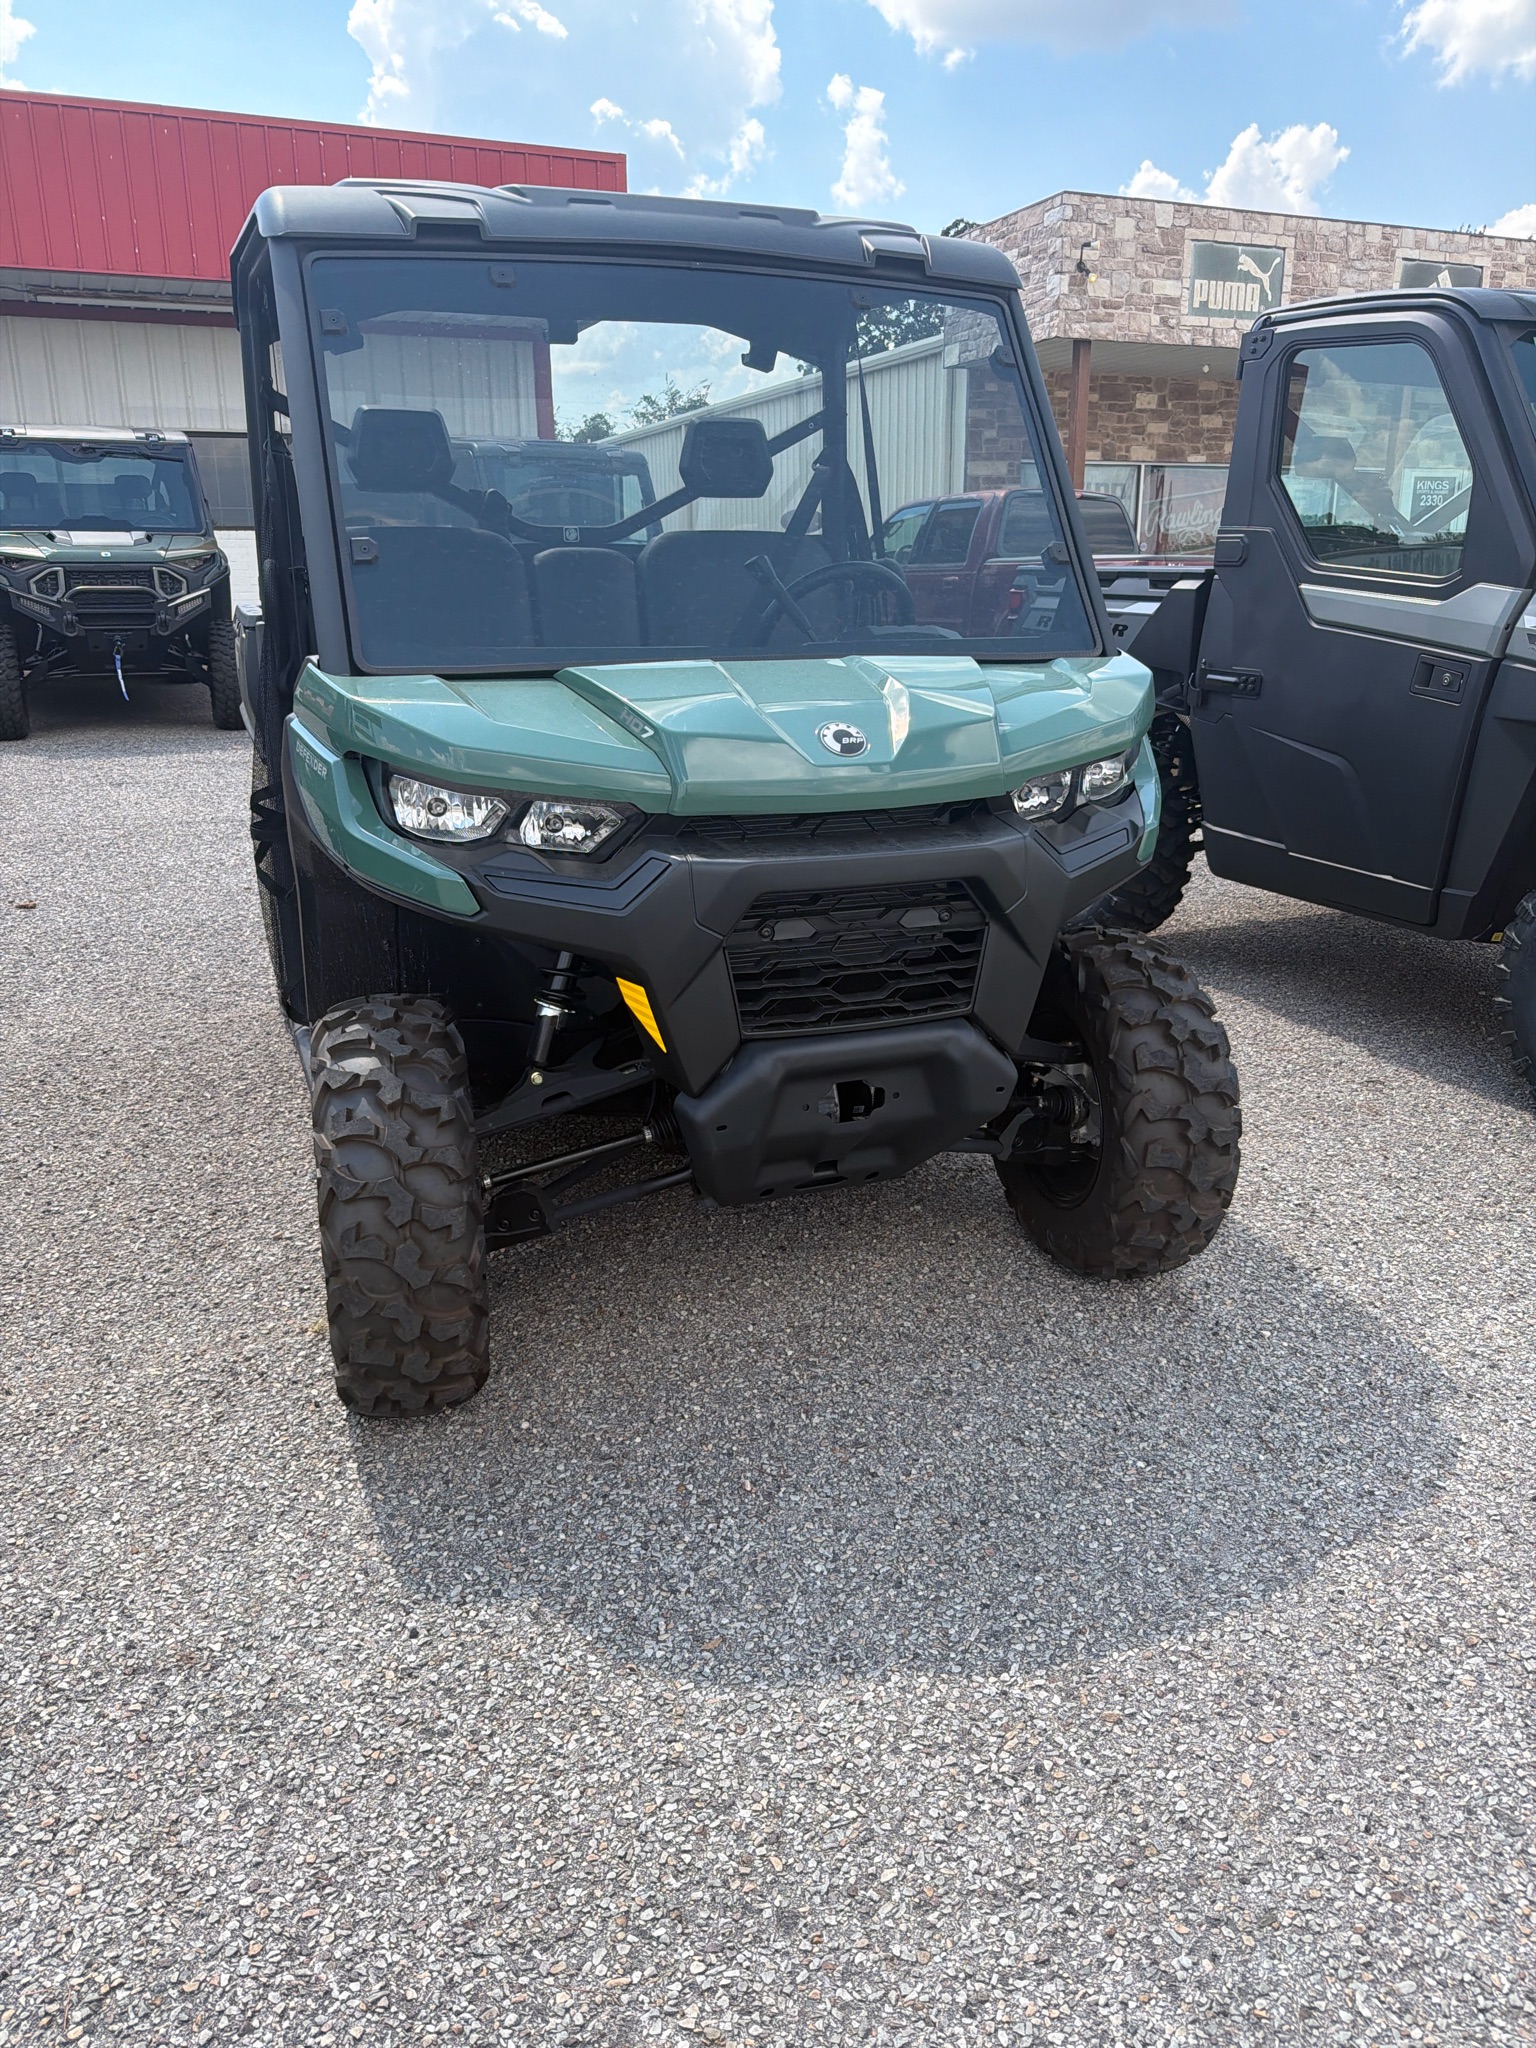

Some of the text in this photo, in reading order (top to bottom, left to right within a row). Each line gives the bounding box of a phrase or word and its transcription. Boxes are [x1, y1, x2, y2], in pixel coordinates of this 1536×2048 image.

[1193, 279, 1260, 312] PUMA
[1416, 480, 1450, 490] KINGS
[1420, 494, 1443, 506] 2330
[619, 707, 655, 738] HD7
[295, 740, 328, 780] DEFENDER
